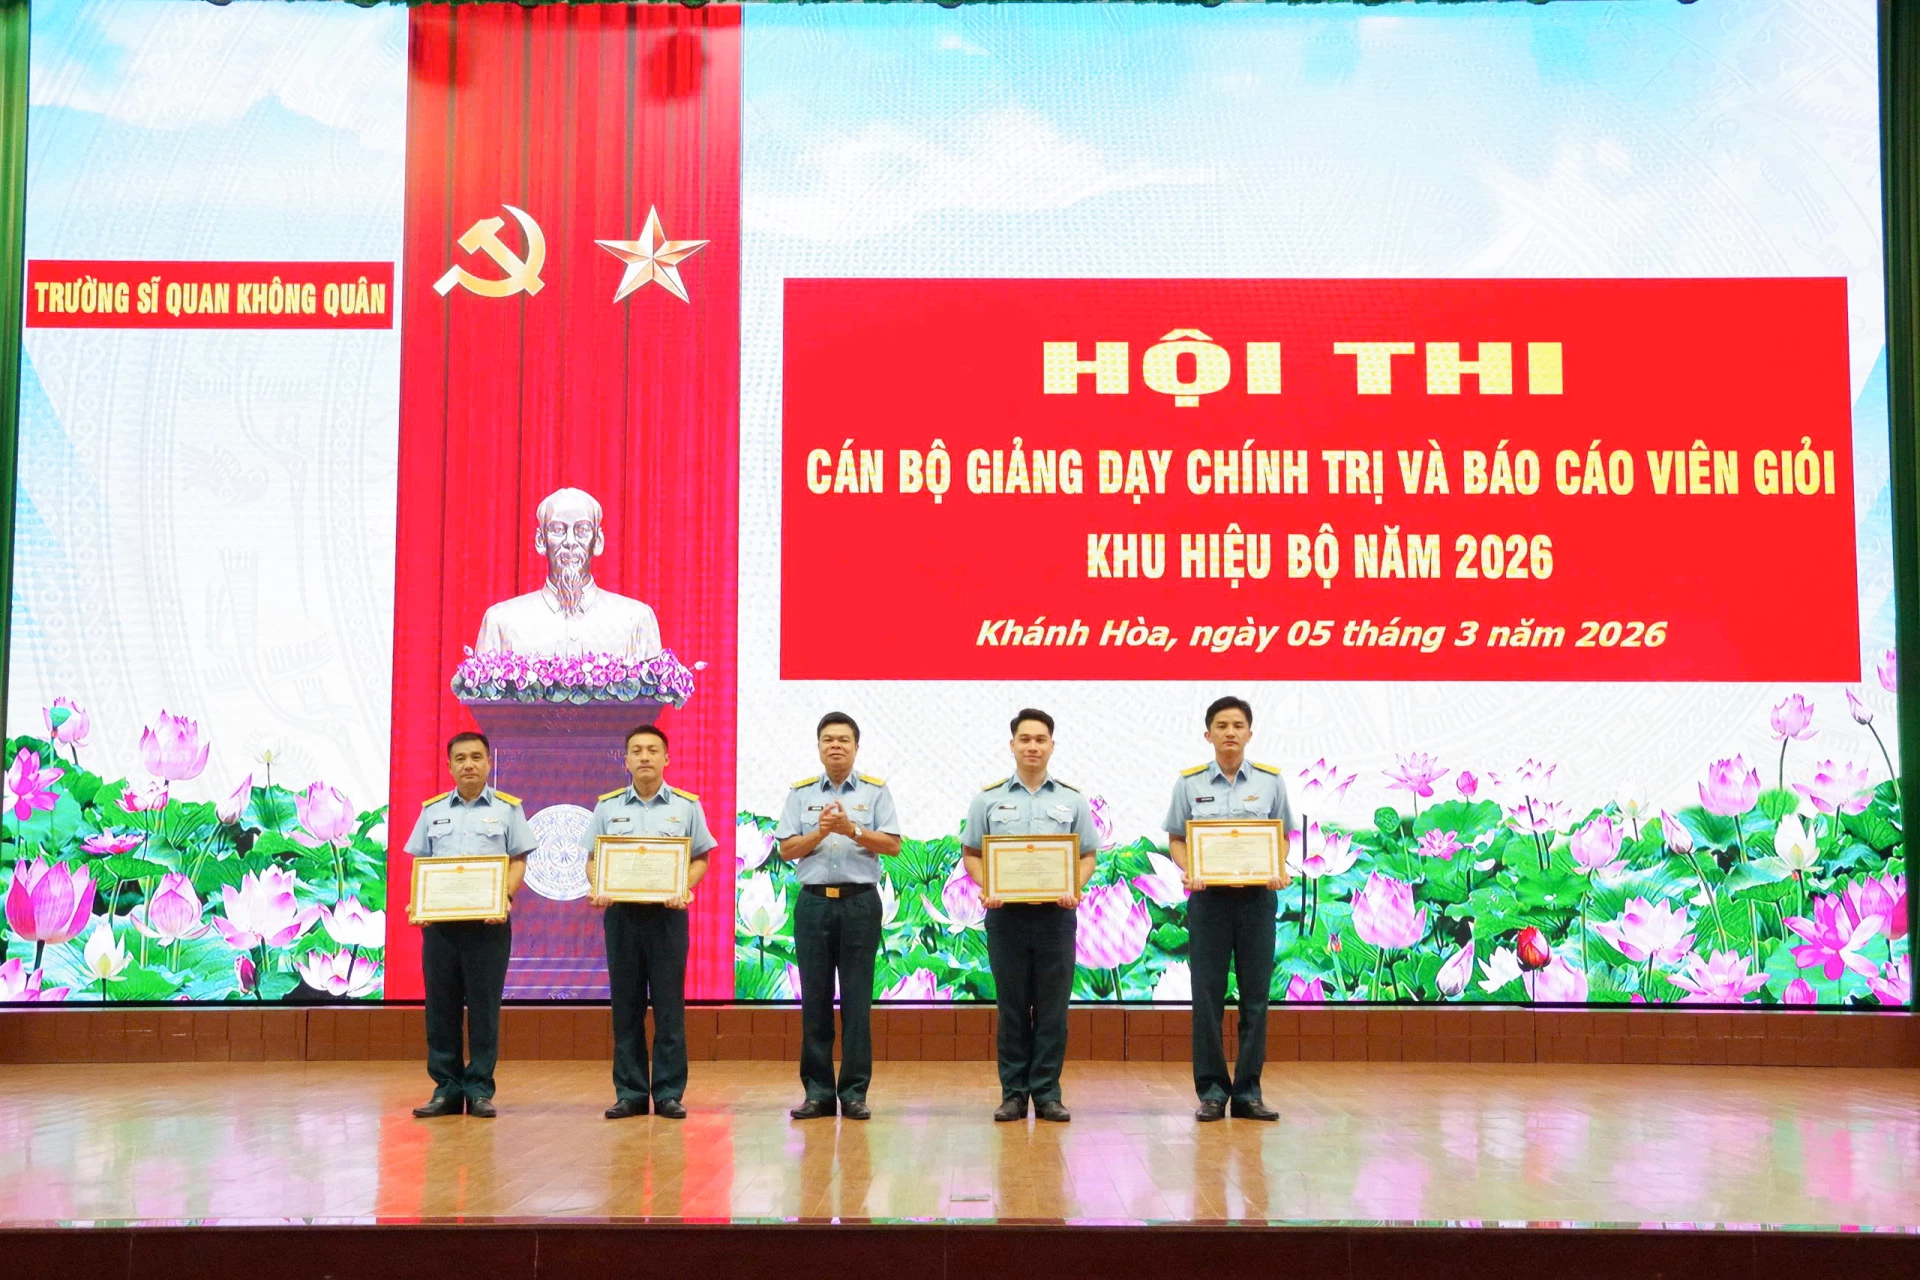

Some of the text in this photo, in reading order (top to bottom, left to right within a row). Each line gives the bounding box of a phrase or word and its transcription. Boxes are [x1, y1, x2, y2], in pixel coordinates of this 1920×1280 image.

[35, 275, 385, 317] TRƯỜNG SĨ QUAN KHÔNG QUÂN
[1044, 329, 1563, 407] HỘI THI
[807, 436, 1835, 504] CÁN BỘ GIẢNG DẠY CHÍNH TRỊ VÀ BÁO CÁO VIÊN GIỎI
[1088, 523, 1553, 588] KHU HIỆU BỘ NĂM 2026
[976, 616, 1668, 653] Khánh Hòa, ngày 05 tháng 3 năm 2026
